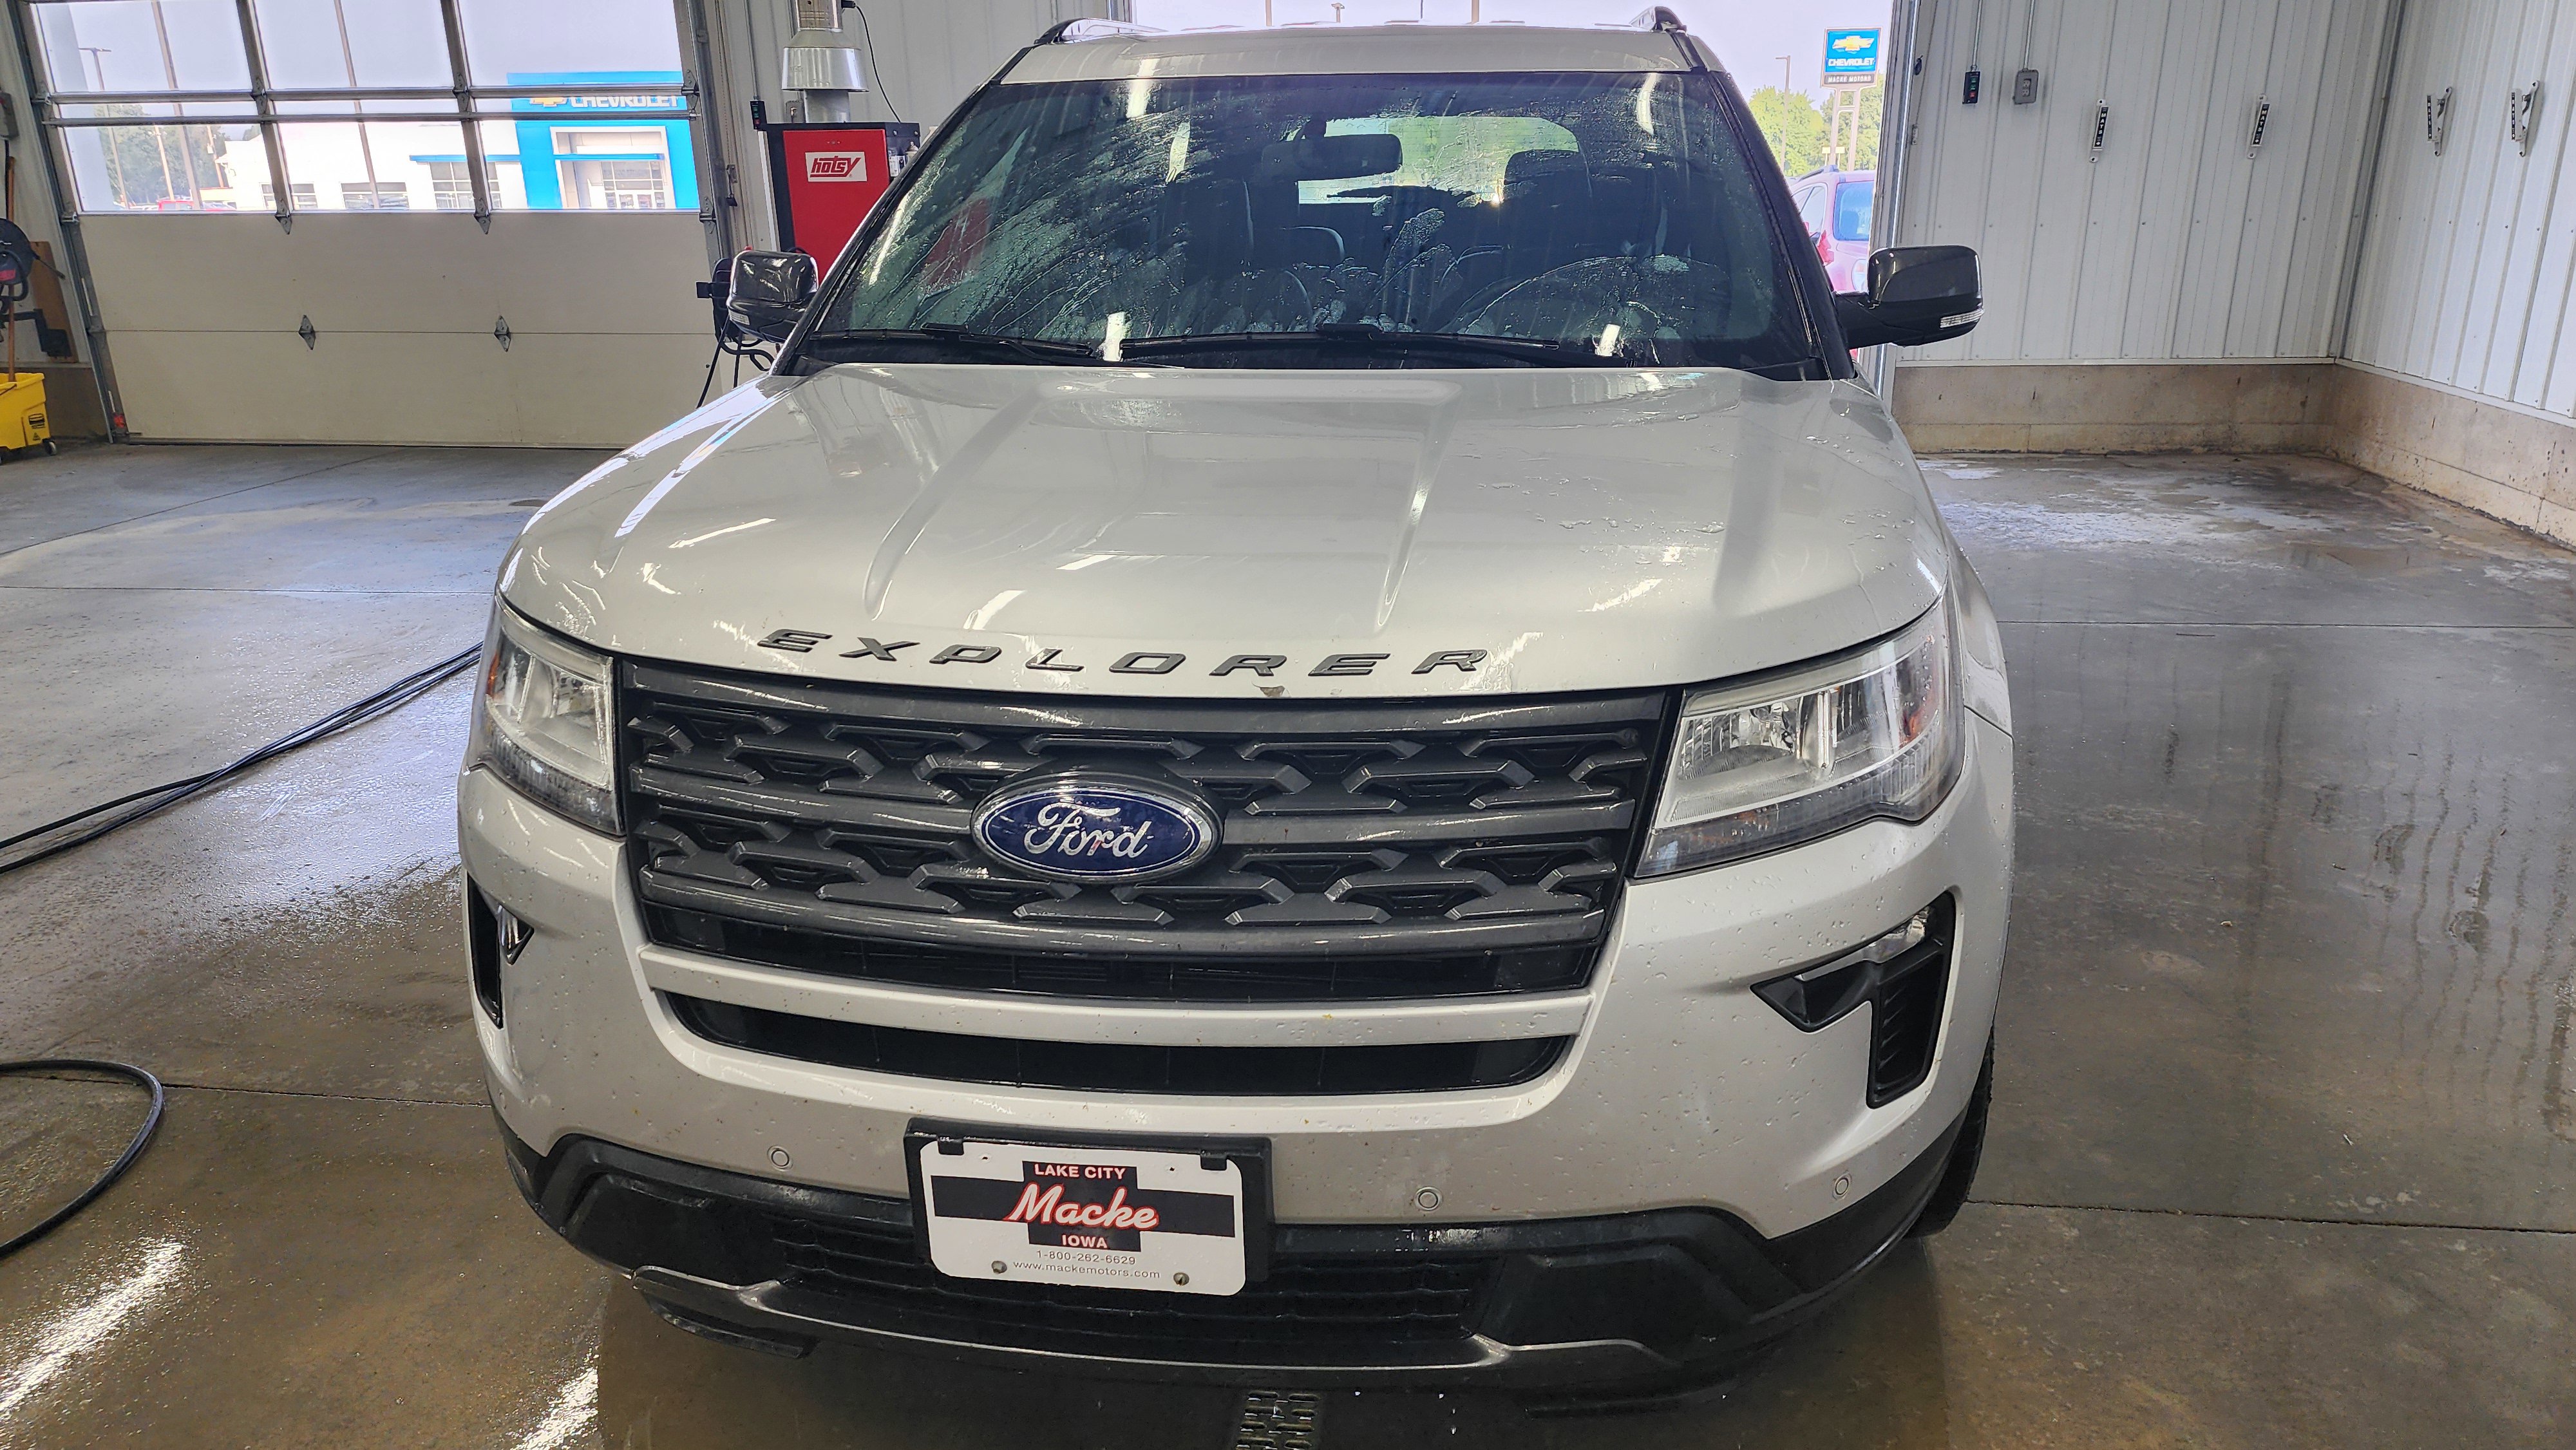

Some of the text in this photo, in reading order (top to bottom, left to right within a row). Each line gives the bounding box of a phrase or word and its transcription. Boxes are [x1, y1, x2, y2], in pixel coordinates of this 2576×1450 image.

[1828, 58, 1875, 66] CHEVROLET
[571, 96, 678, 108] CHEVROLET
[2098, 113, 2107, 135] MATS
[2257, 110, 2267, 132] MATS
[757, 628, 1488, 677] EXPLORER
[1024, 800, 1151, 858] Ford
[1034, 1163, 1126, 1180] LAKE CITY
[1007, 1182, 1159, 1229] Macke
[1061, 1234, 1108, 1248] IOWA
[1036, 1250, 1136, 1265] 1-800-262-6629
[1013, 1261, 1160, 1279] www.mackemotors.com
